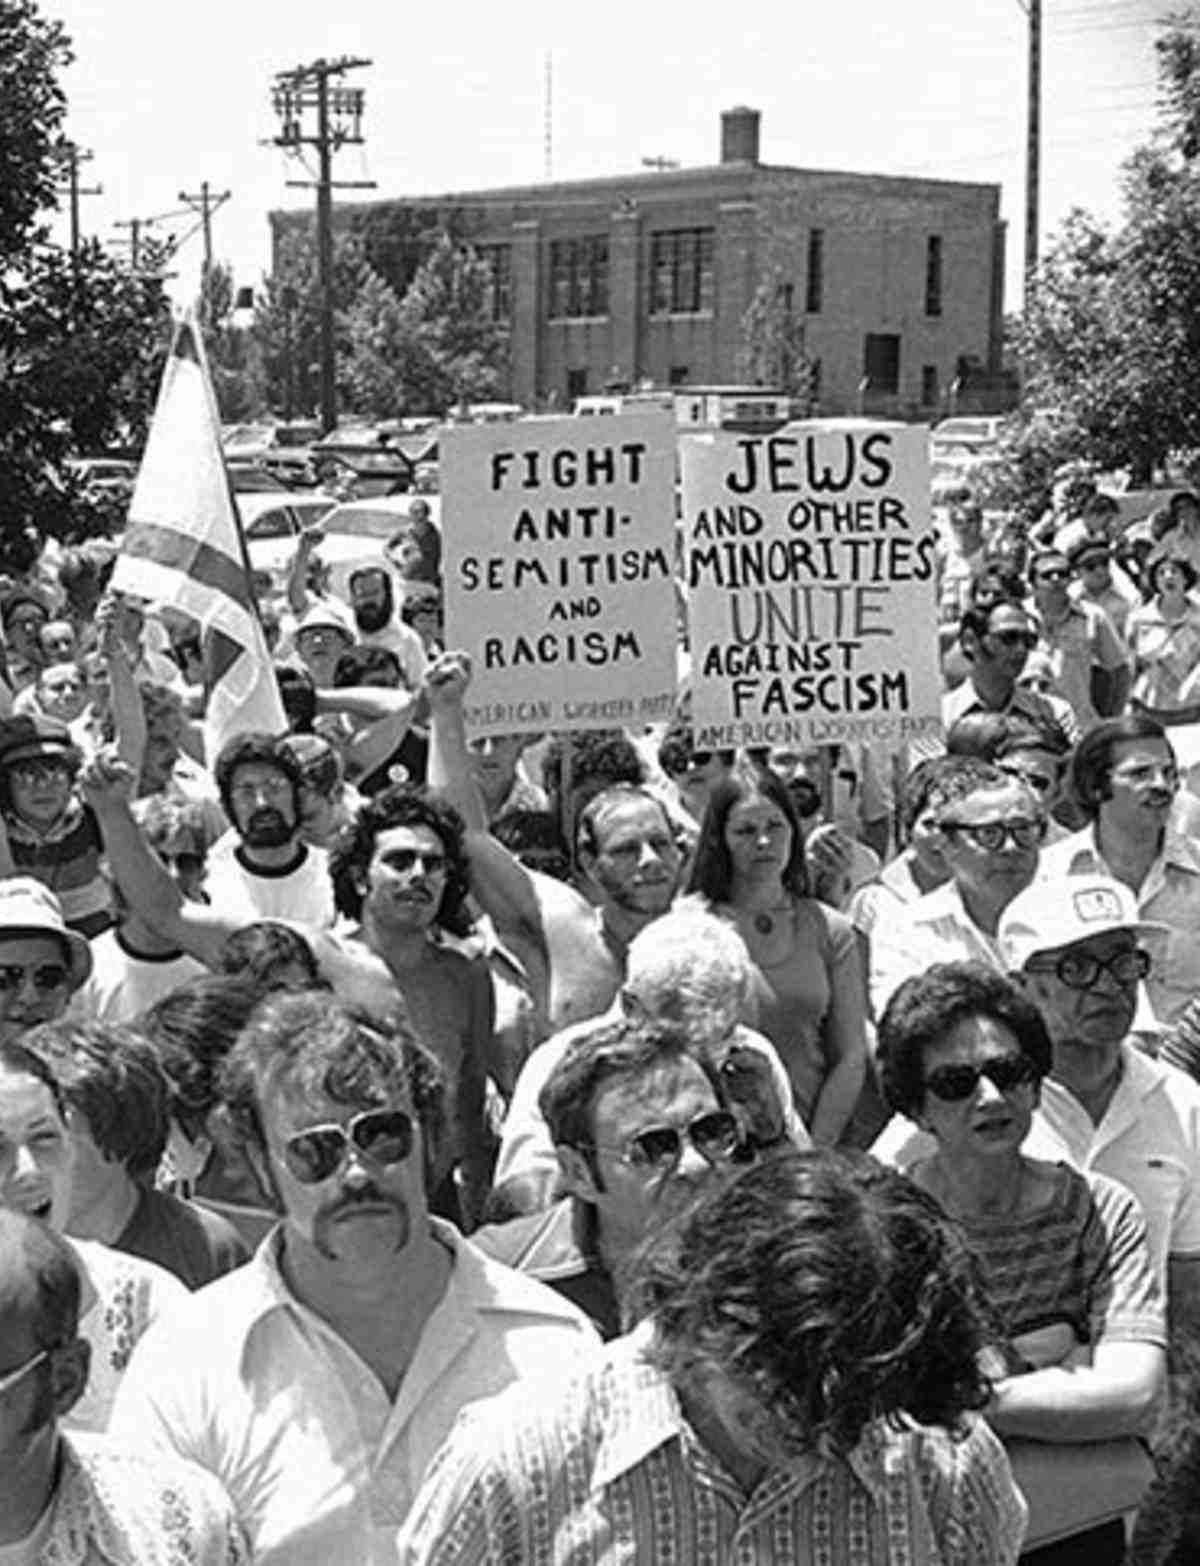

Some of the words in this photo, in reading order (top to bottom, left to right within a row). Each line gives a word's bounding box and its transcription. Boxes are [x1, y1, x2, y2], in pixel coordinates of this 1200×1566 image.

[491, 443, 646, 491] FIGHT
[725, 433, 892, 494] JEWS
[513, 507, 631, 541] ANTI-
[692, 505, 763, 540] AND
[787, 496, 909, 532] OTHER
[460, 547, 669, 591] SEMITISM
[550, 596, 602, 621] AND
[731, 586, 894, 645] UNITE
[485, 631, 642, 669] RACISM
[703, 641, 862, 676] AGAINST
[732, 671, 909, 719] FASCISM
[696, 718, 801, 748] AMERICAN
